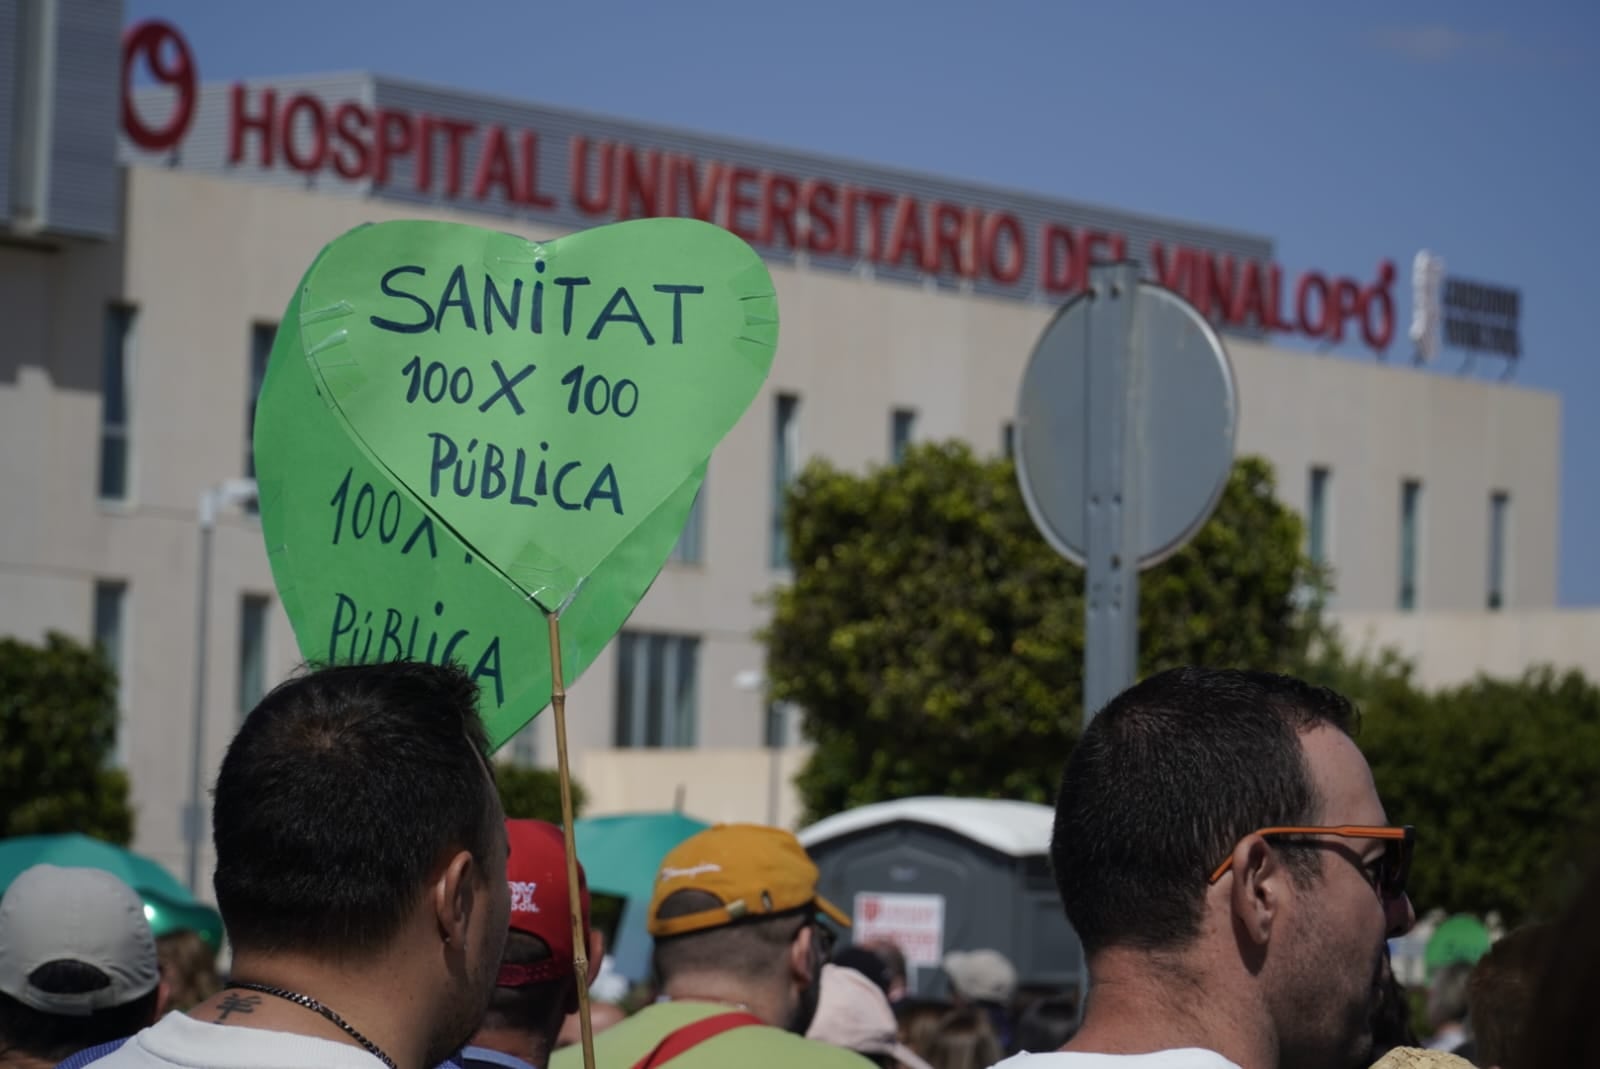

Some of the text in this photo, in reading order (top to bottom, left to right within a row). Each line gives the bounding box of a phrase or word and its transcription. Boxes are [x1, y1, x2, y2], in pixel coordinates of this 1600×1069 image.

[228, 80, 556, 210] HOSPITAL
[568, 134, 1026, 286] UNIVERSITARIO
[1149, 238, 1397, 352] VINALOPÓ
[561, 364, 639, 418] 100
